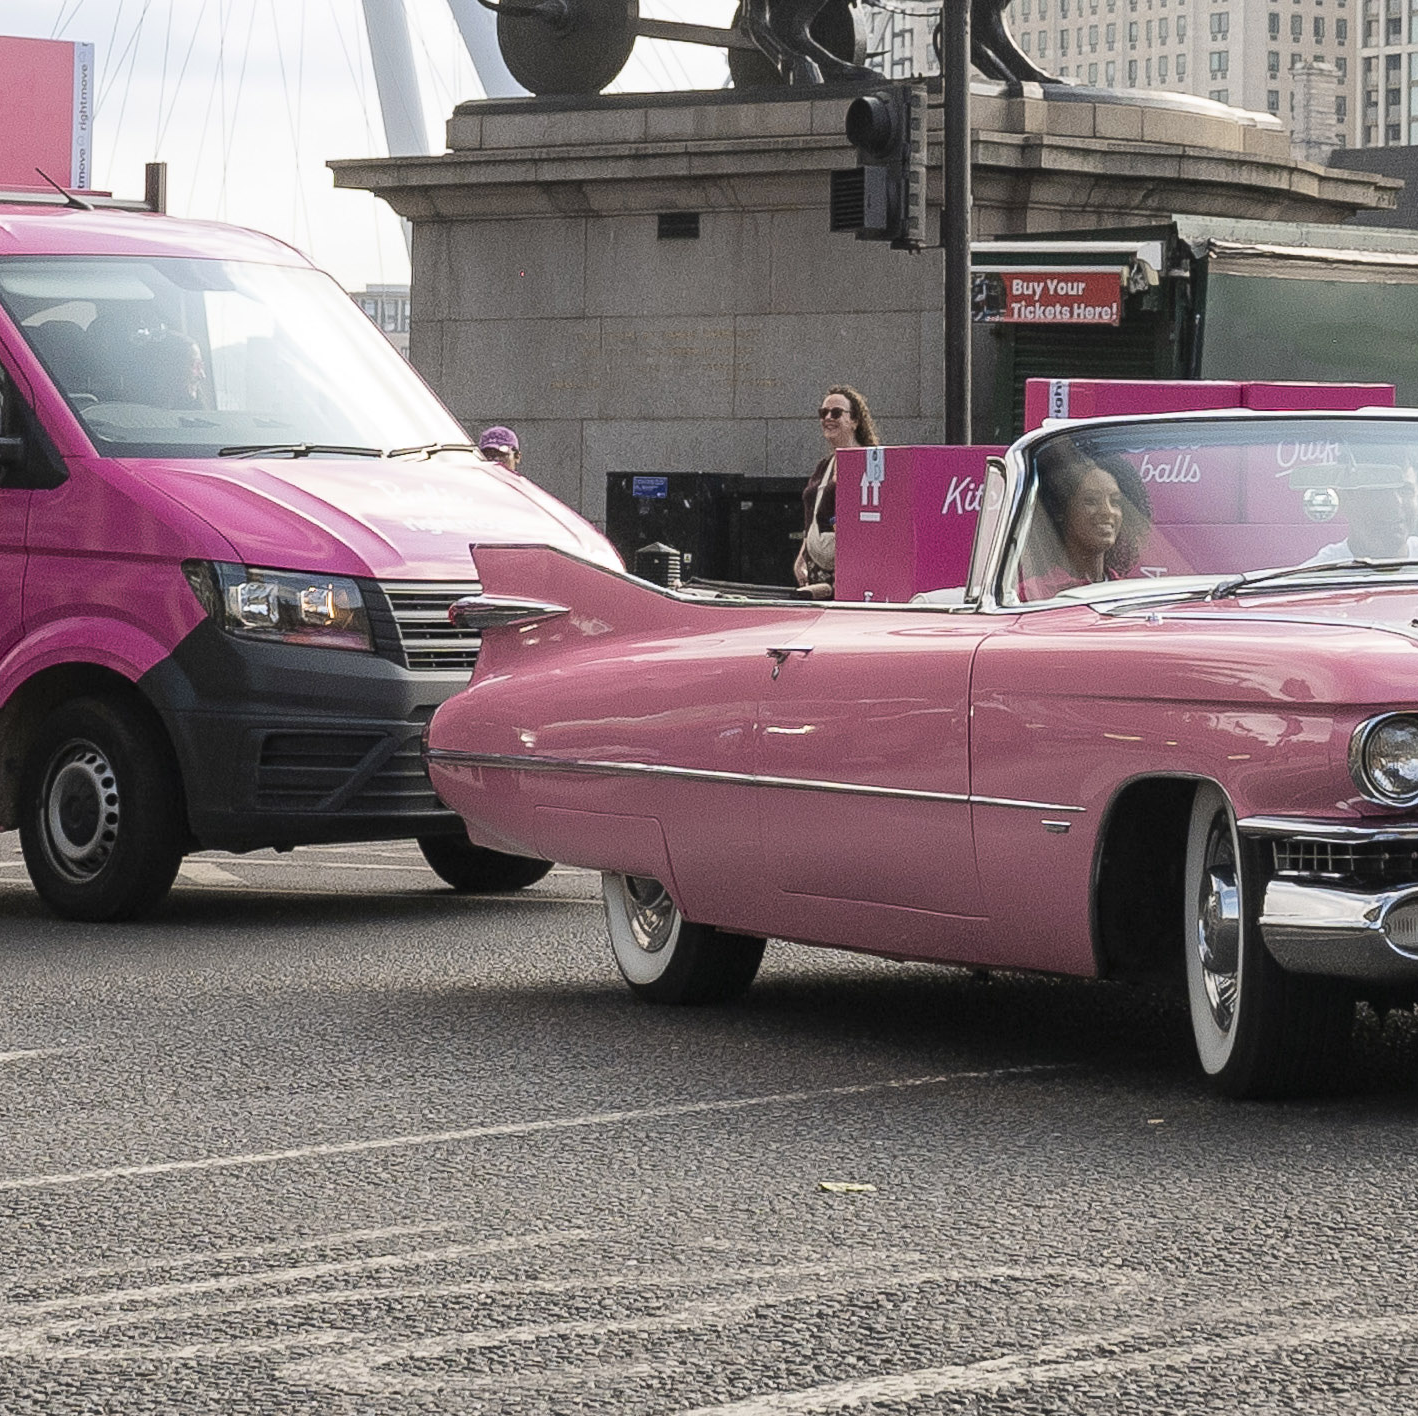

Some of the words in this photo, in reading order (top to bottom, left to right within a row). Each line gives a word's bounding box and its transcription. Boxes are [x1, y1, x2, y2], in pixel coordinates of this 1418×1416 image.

[79, 64, 89, 131] rightmove
[1011, 278, 1045, 301] Buy
[1046, 278, 1086, 296] Your
[1010, 300, 1070, 320] Tickets
[1072, 302, 1118, 320] Here!
[1139, 454, 1201, 483] balls
